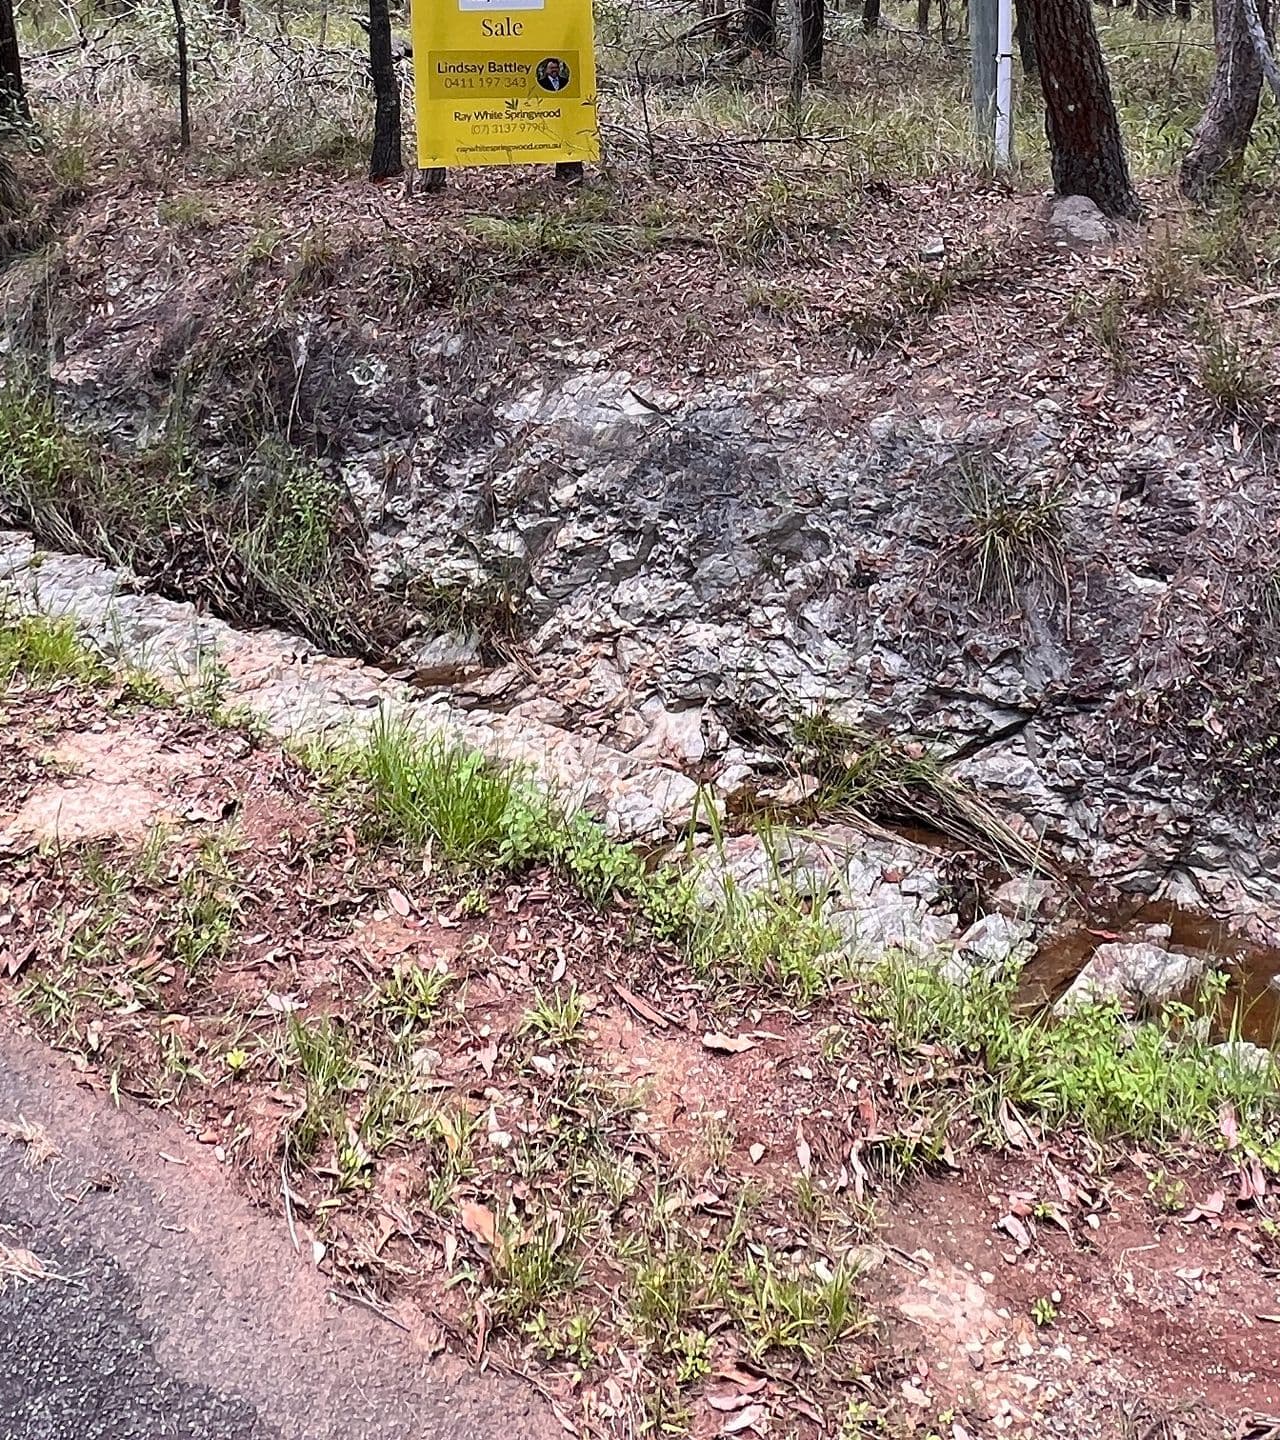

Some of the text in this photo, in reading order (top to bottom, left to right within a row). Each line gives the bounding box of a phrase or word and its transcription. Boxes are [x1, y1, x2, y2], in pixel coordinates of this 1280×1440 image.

[481, 17, 524, 37] Sale
[437, 61, 531, 74] Lindsay Battley
[444, 77, 527, 88] 0411 197 343
[454, 108, 560, 122] Ray White Springwood
[471, 125, 489, 135] (07)
[493, 123, 516, 134] 3137
